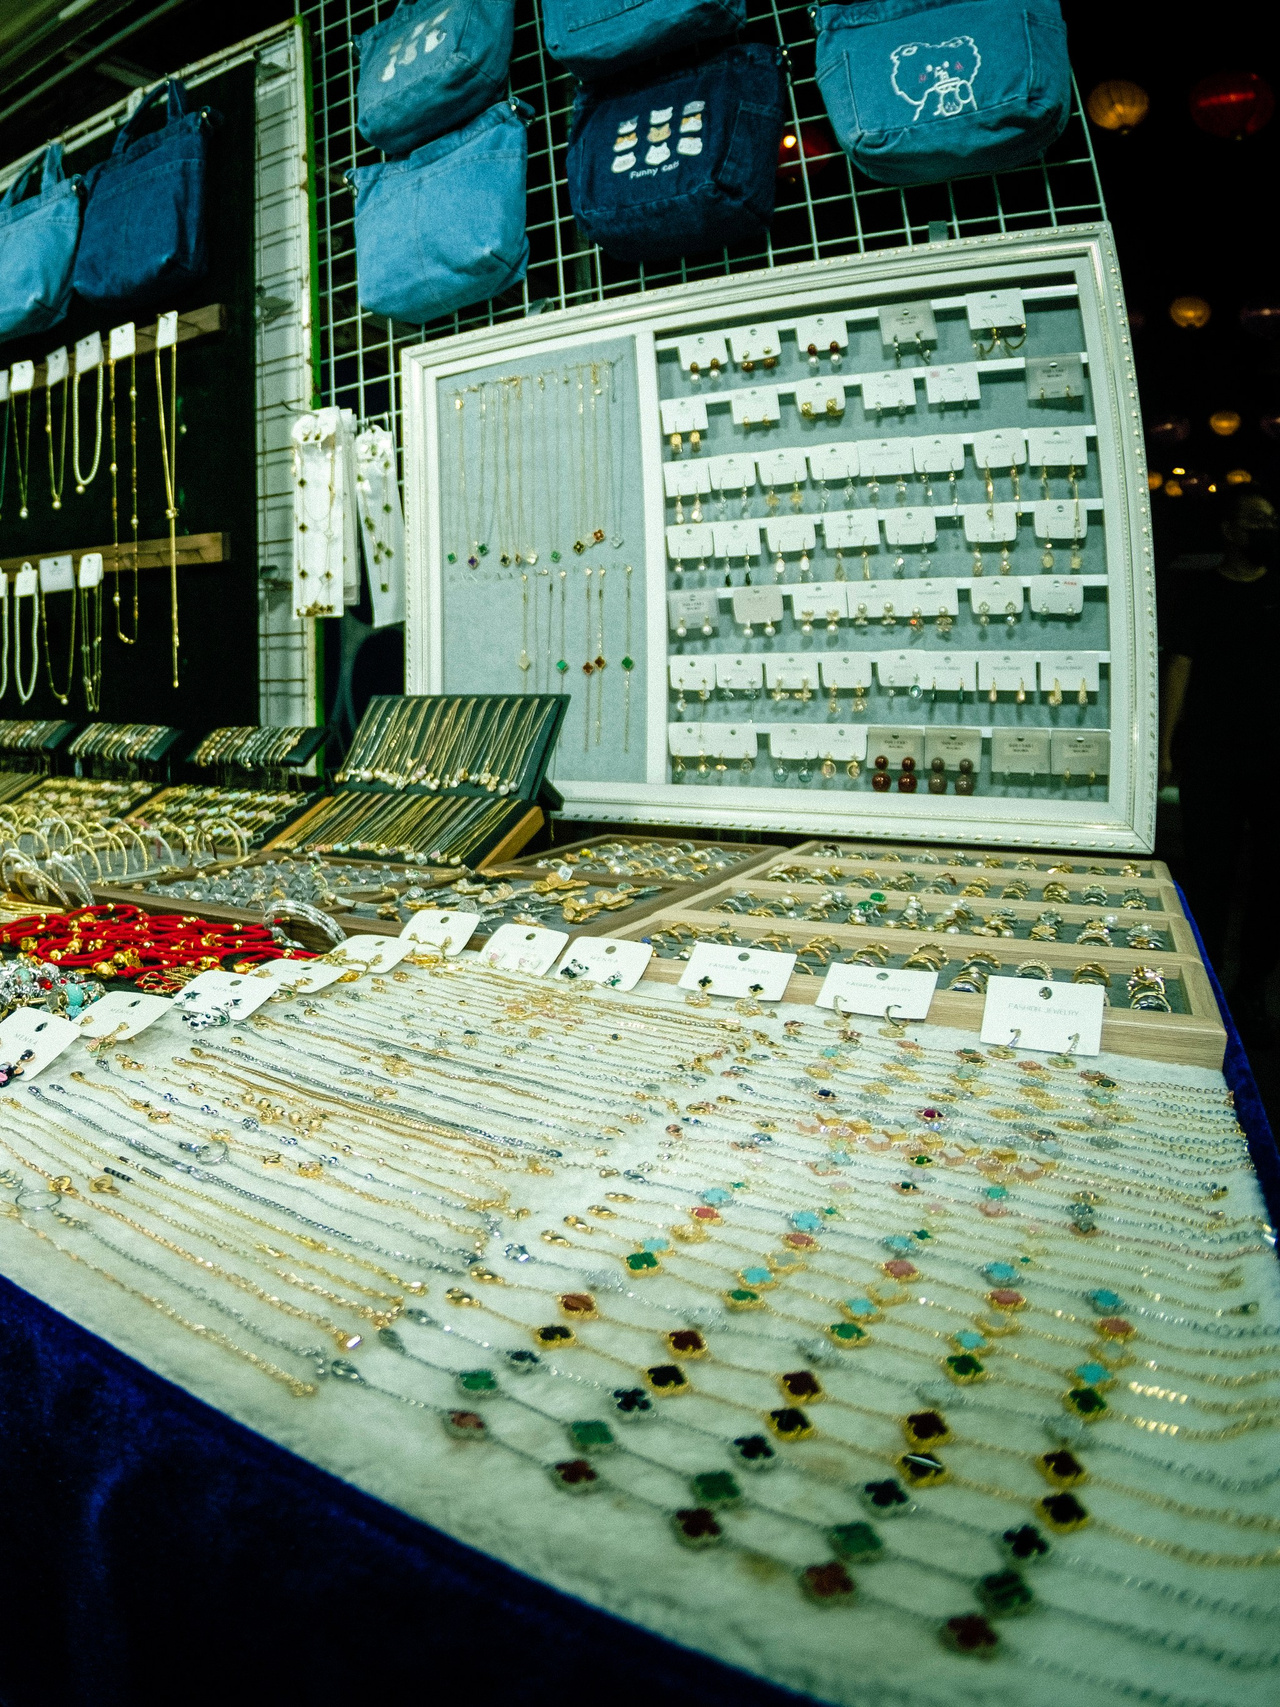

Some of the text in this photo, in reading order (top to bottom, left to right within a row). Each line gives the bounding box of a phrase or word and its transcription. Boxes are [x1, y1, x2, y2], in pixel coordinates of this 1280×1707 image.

[629, 167, 659, 180] Funny
[1007, 1002, 1081, 1017] FASHION JEWELRY
